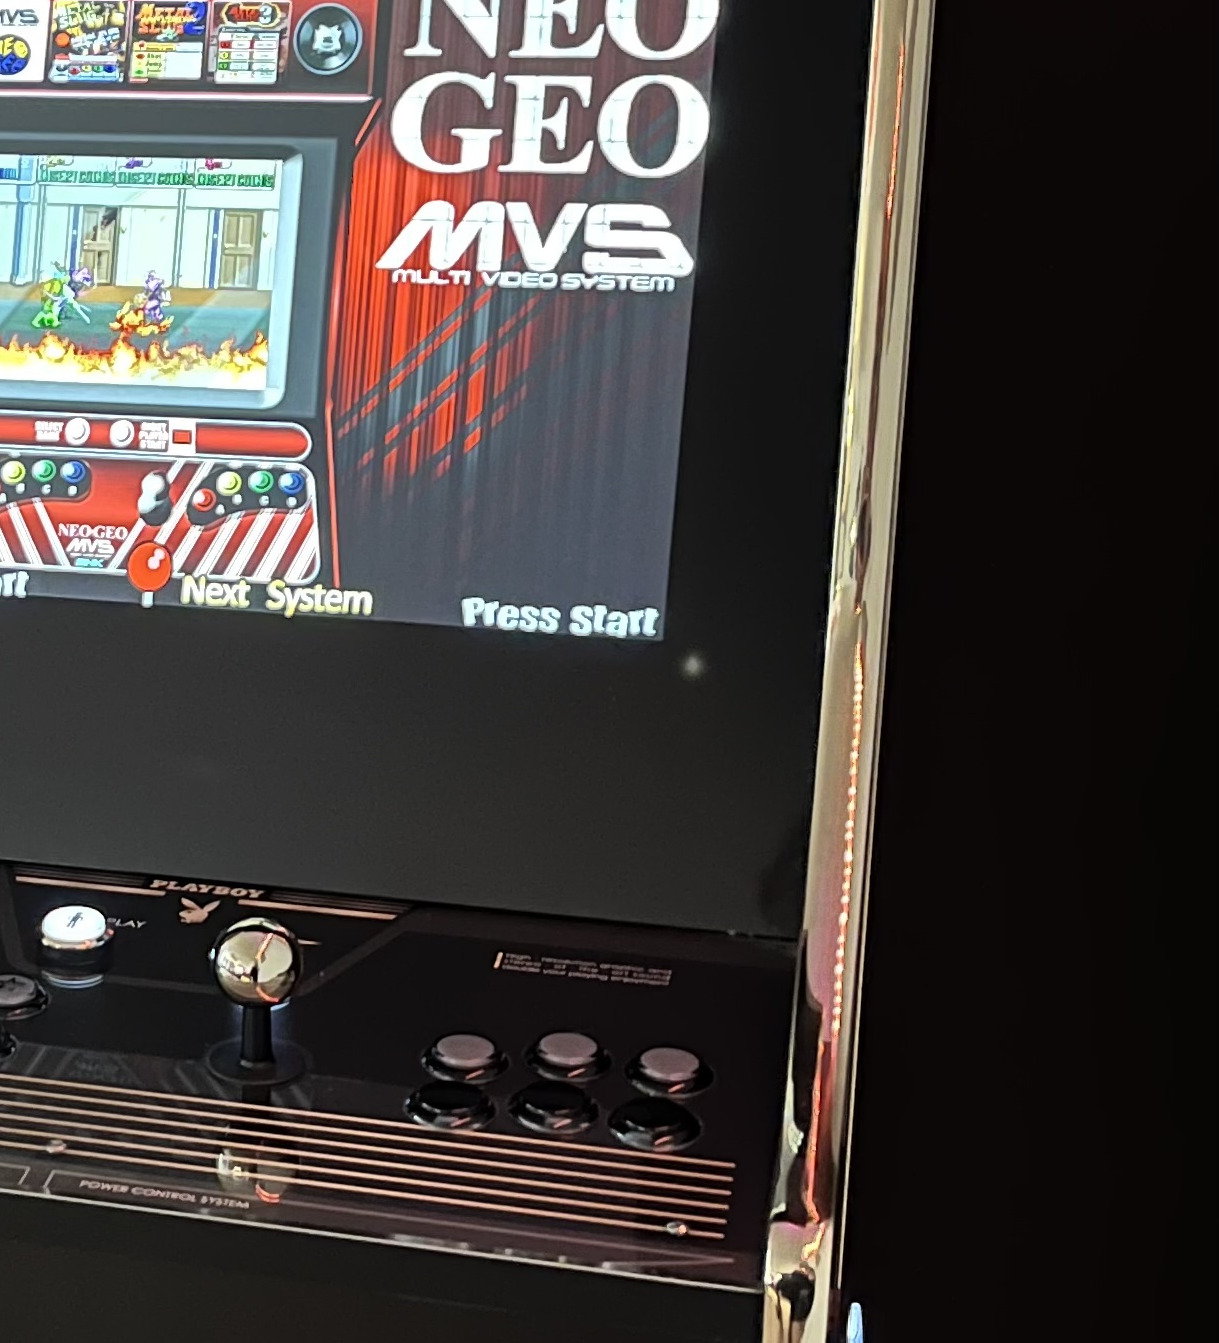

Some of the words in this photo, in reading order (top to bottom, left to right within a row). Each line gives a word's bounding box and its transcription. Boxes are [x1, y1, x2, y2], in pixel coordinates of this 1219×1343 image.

[390, 71, 710, 178] GEO
[375, 200, 694, 277] MVS
[392, 268, 471, 285] MULTI
[483, 271, 558, 289] VIDEO
[561, 272, 675, 291] SYSTEM
[66, 538, 115, 554] MVS
[181, 575, 251, 608] Next
[264, 579, 373, 619] System
[461, 596, 561, 634] Press
[569, 604, 659, 638] Start
[149, 880, 265, 899] PLAYBOY
[79, 1179, 129, 1193] POWER
[131, 1186, 196, 1202] CONTROL
[200, 1195, 250, 1209] SYSTEM
